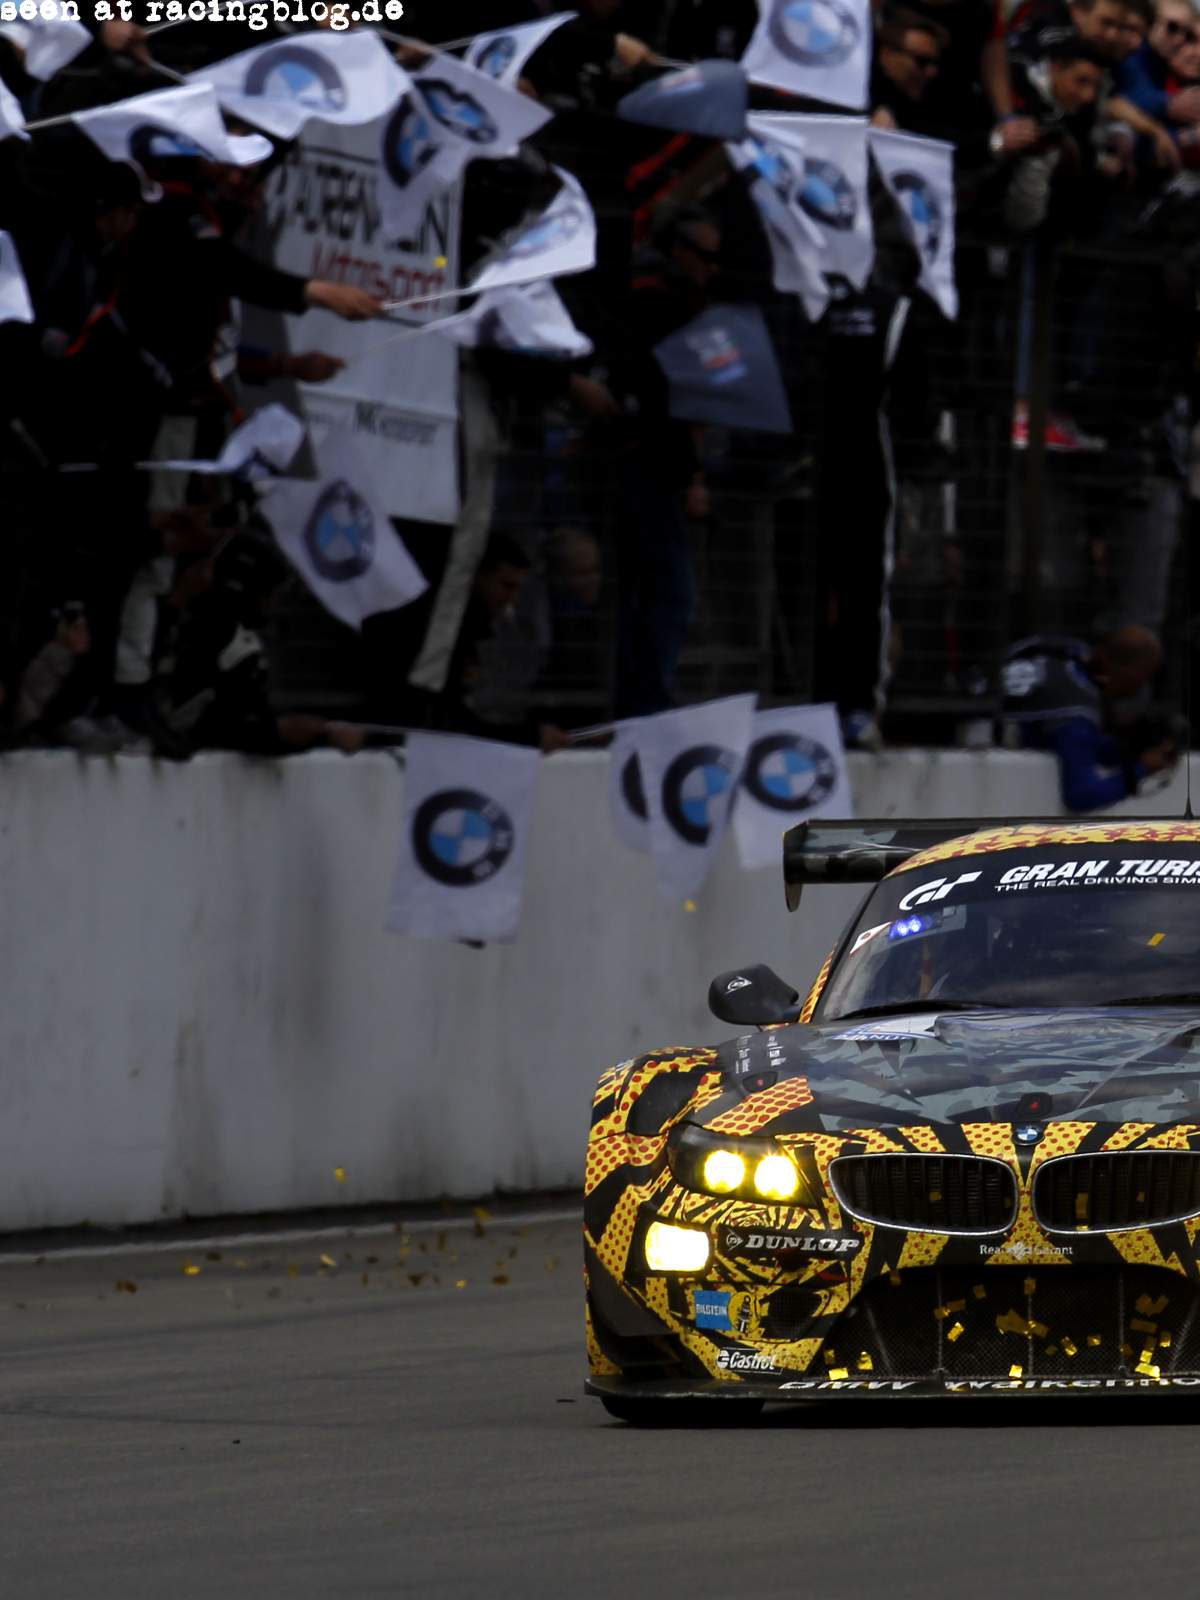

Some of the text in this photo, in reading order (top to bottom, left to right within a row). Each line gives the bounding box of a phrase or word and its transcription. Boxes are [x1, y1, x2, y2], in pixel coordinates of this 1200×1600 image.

[1000, 860, 1110, 884] GRAN
[994, 881, 1030, 892] THE
[1034, 878, 1080, 889] REAL
[1084, 876, 1158, 885] DRIVING
[745, 1233, 860, 1252] DUNLOP
[730, 1350, 775, 1370] Castrol
